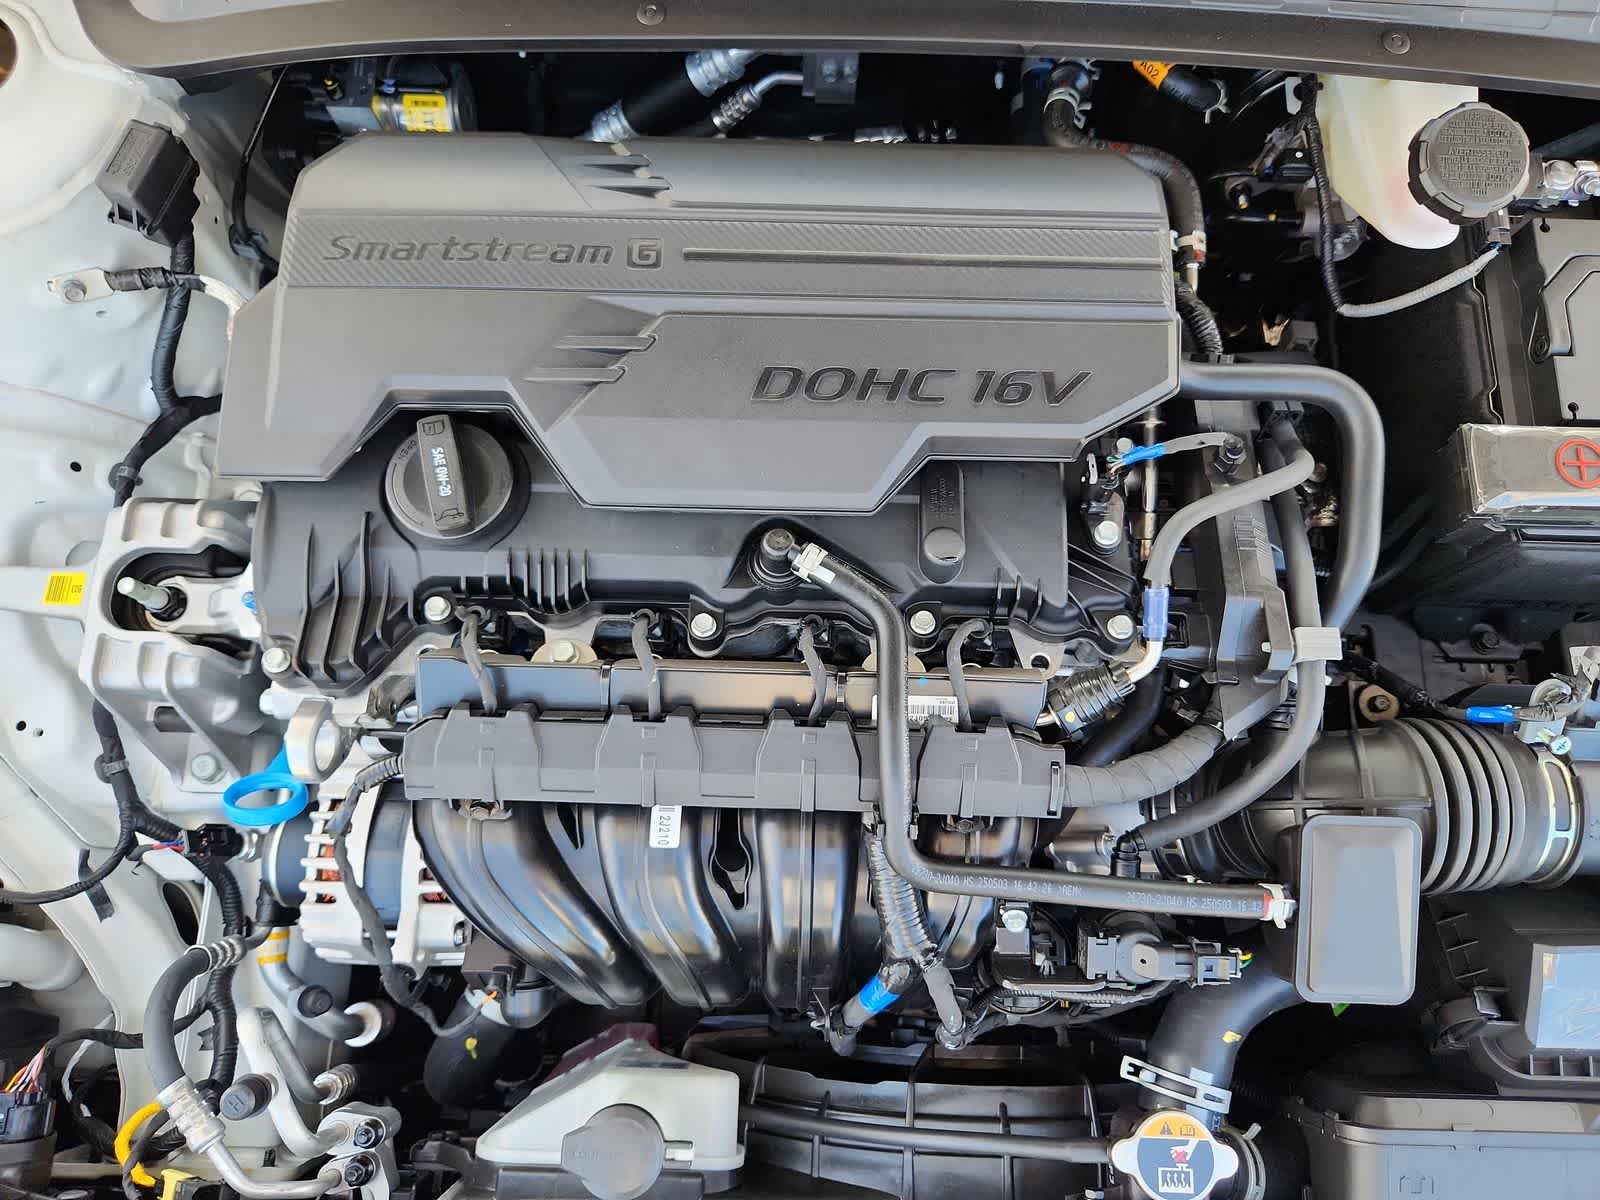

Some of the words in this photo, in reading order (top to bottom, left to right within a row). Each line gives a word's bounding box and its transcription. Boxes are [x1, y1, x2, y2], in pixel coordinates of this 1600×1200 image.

[323, 235, 615, 265] Smartstream
[629, 238, 661, 269] G
[751, 365, 957, 402] DOHC
[970, 369, 1093, 407] 16V
[431, 447, 446, 466] SAE
[434, 467, 452, 497] 0W-20
